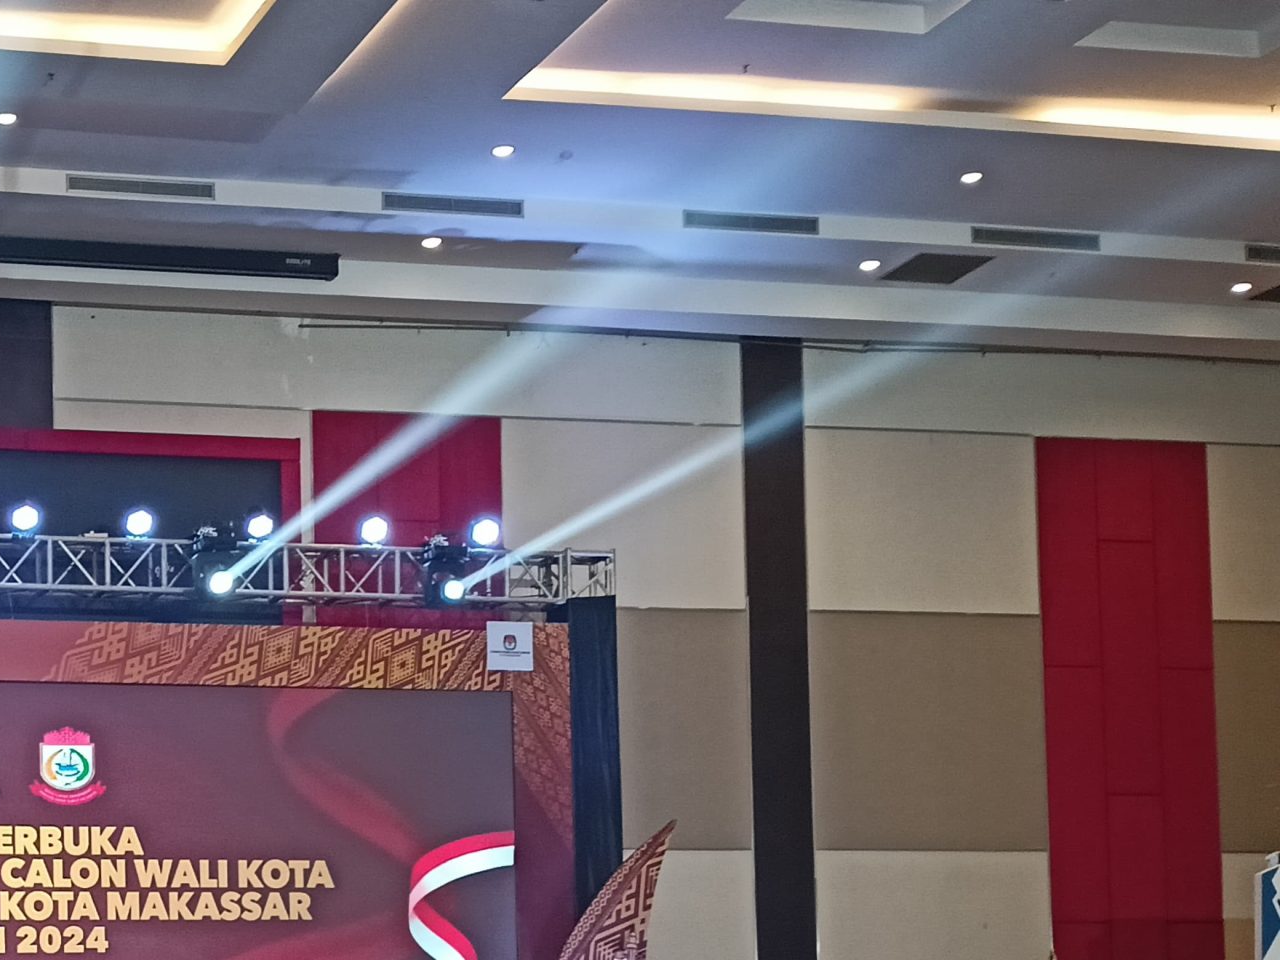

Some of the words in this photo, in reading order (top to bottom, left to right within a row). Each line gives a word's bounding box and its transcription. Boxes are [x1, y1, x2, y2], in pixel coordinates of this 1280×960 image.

[0, 857, 127, 889] CALON
[133, 859, 228, 889] WALI
[237, 858, 336, 889] KOTA
[106, 891, 313, 922] MAKASSAR
[15, 926, 110, 955] 2024
